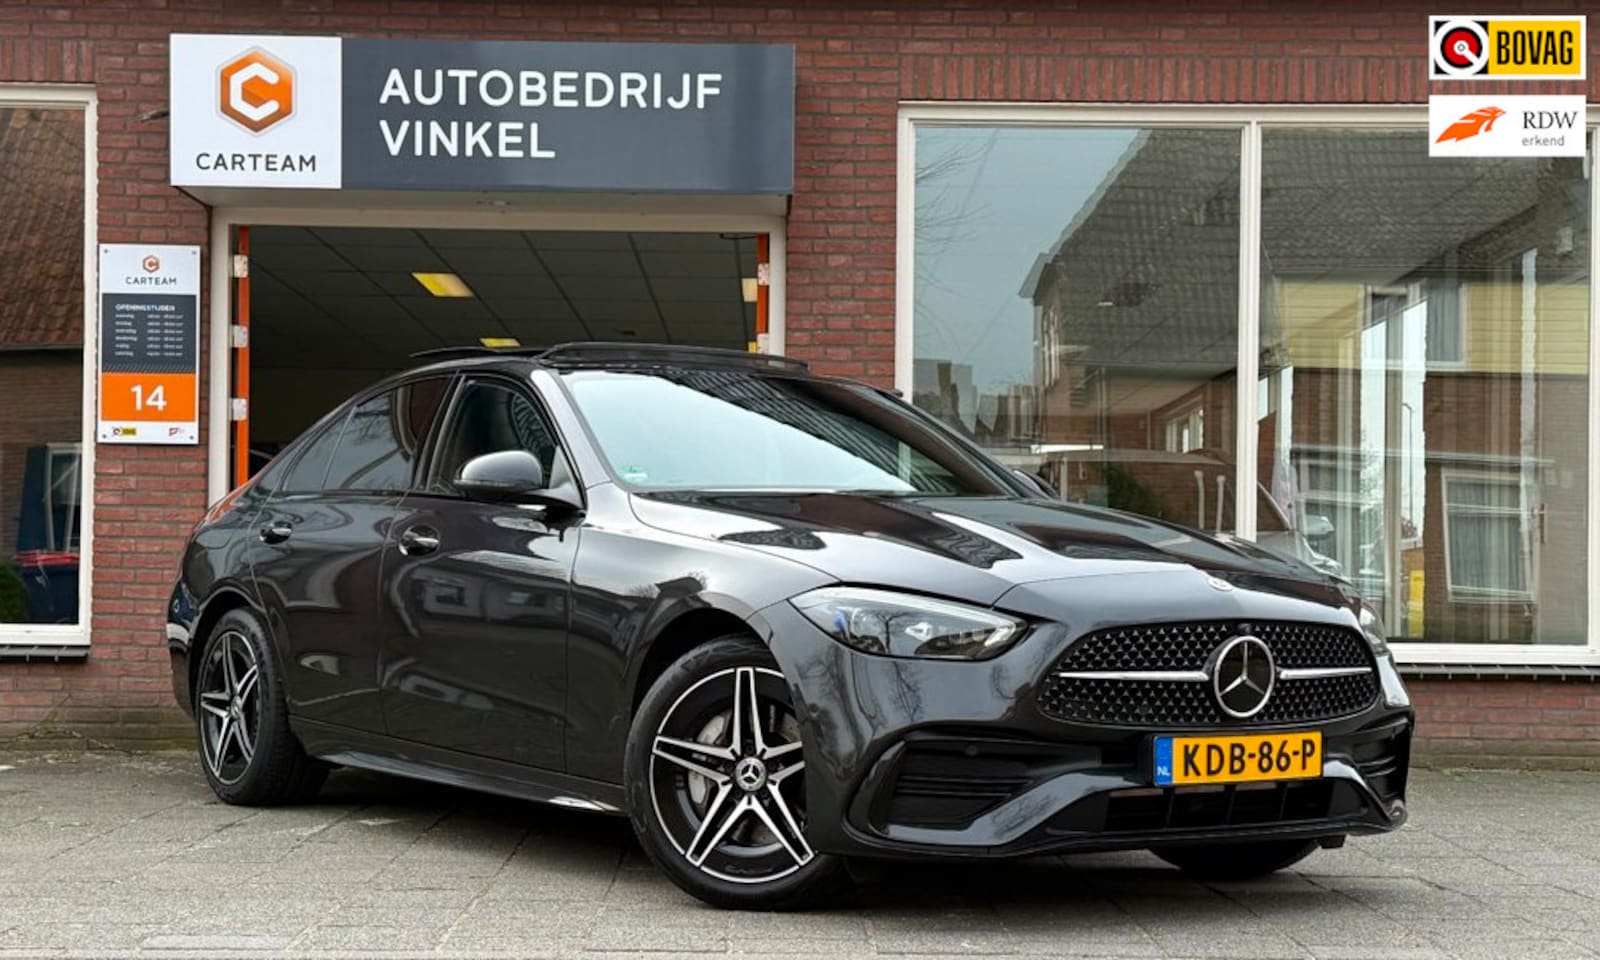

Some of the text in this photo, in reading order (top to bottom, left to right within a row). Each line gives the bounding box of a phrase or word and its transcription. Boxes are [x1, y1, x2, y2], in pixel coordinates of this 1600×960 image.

[379, 68, 723, 109] AUTOBEDRIJF
[379, 119, 556, 159] VINKEL
[195, 152, 317, 173] CARTEAM
[125, 276, 178, 286] CARTEAM
[130, 383, 168, 412] 14
[1156, 765, 1171, 777] NL
[1183, 738, 1316, 778] KDB-86-P
